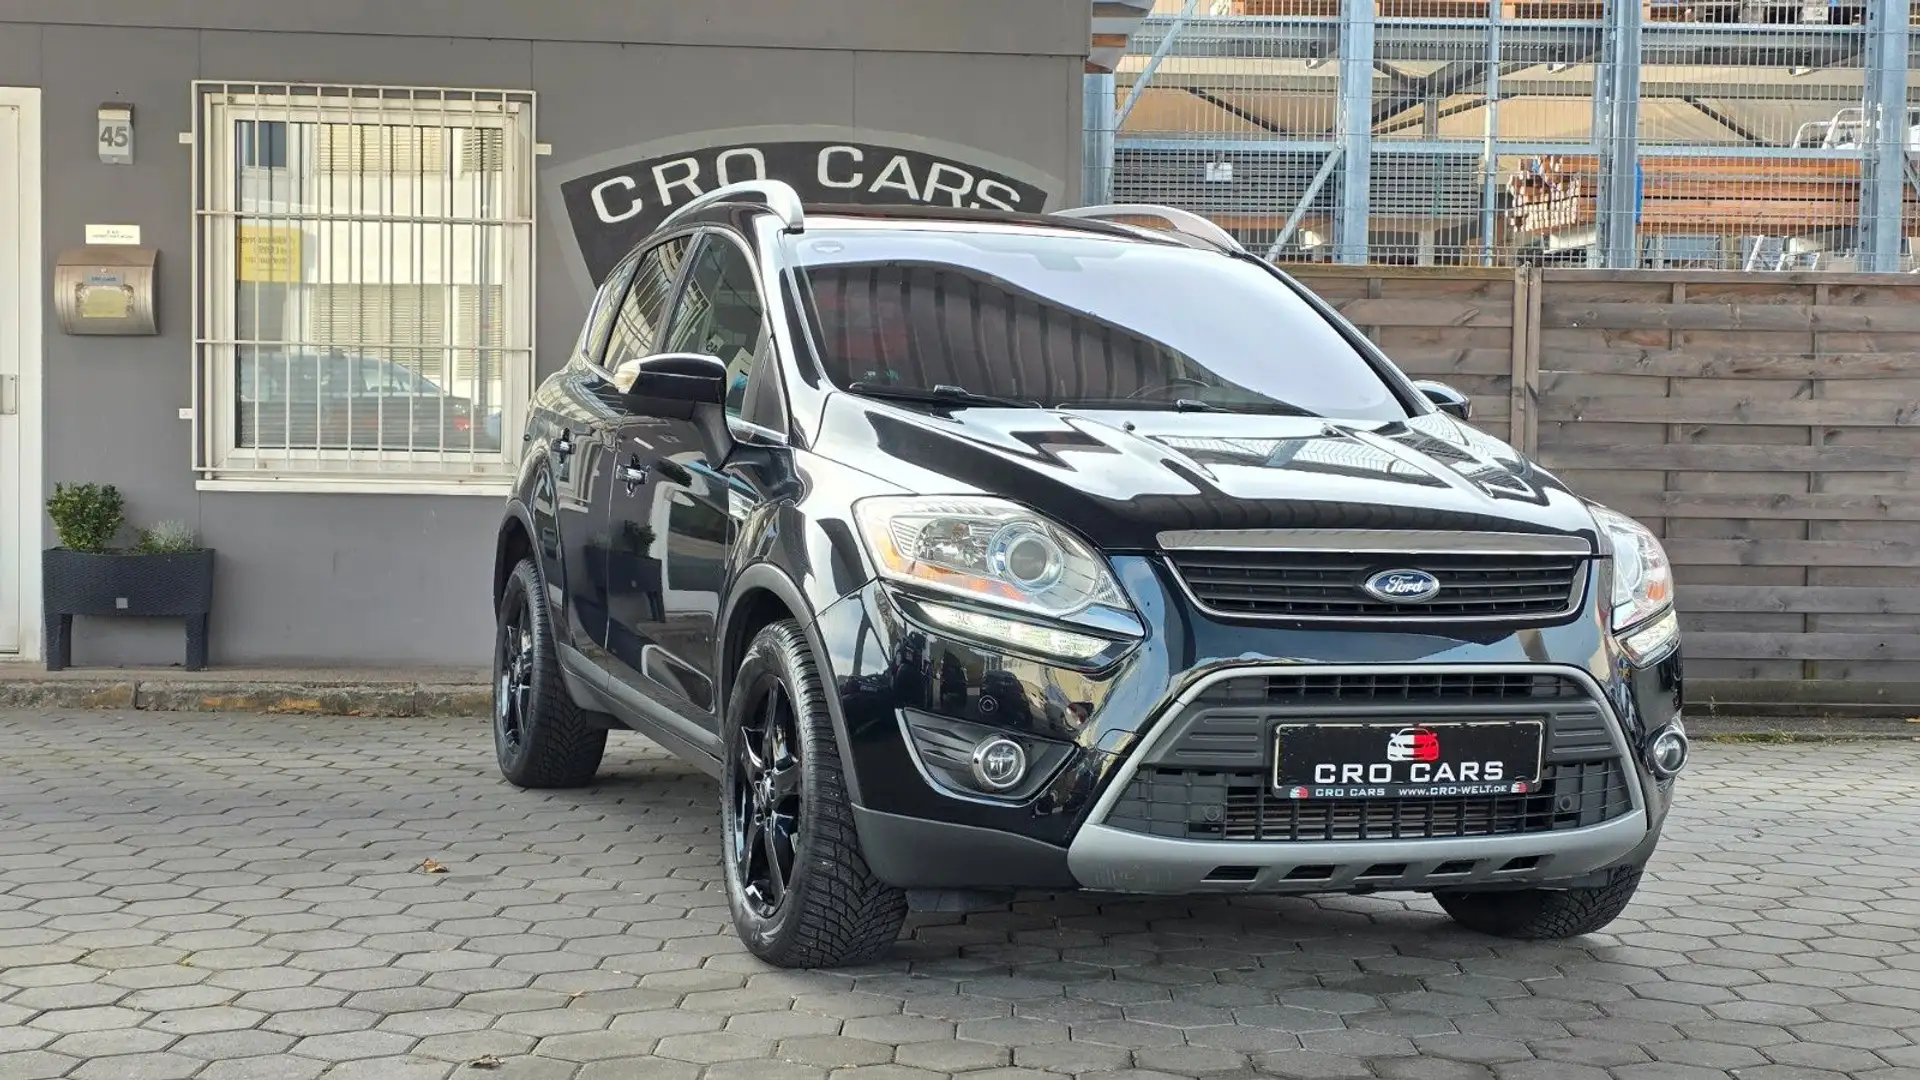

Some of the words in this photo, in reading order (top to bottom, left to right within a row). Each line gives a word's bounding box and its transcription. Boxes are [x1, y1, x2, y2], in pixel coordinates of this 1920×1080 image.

[100, 126, 129, 148] 45
[591, 147, 767, 224] CRO
[817, 145, 1021, 212] CARS
[1385, 575, 1424, 593] Ford
[1315, 763, 1392, 784] CRO
[1410, 760, 1504, 783] CARS
[1315, 788, 1344, 797] CRO
[1349, 787, 1386, 797] CARS
